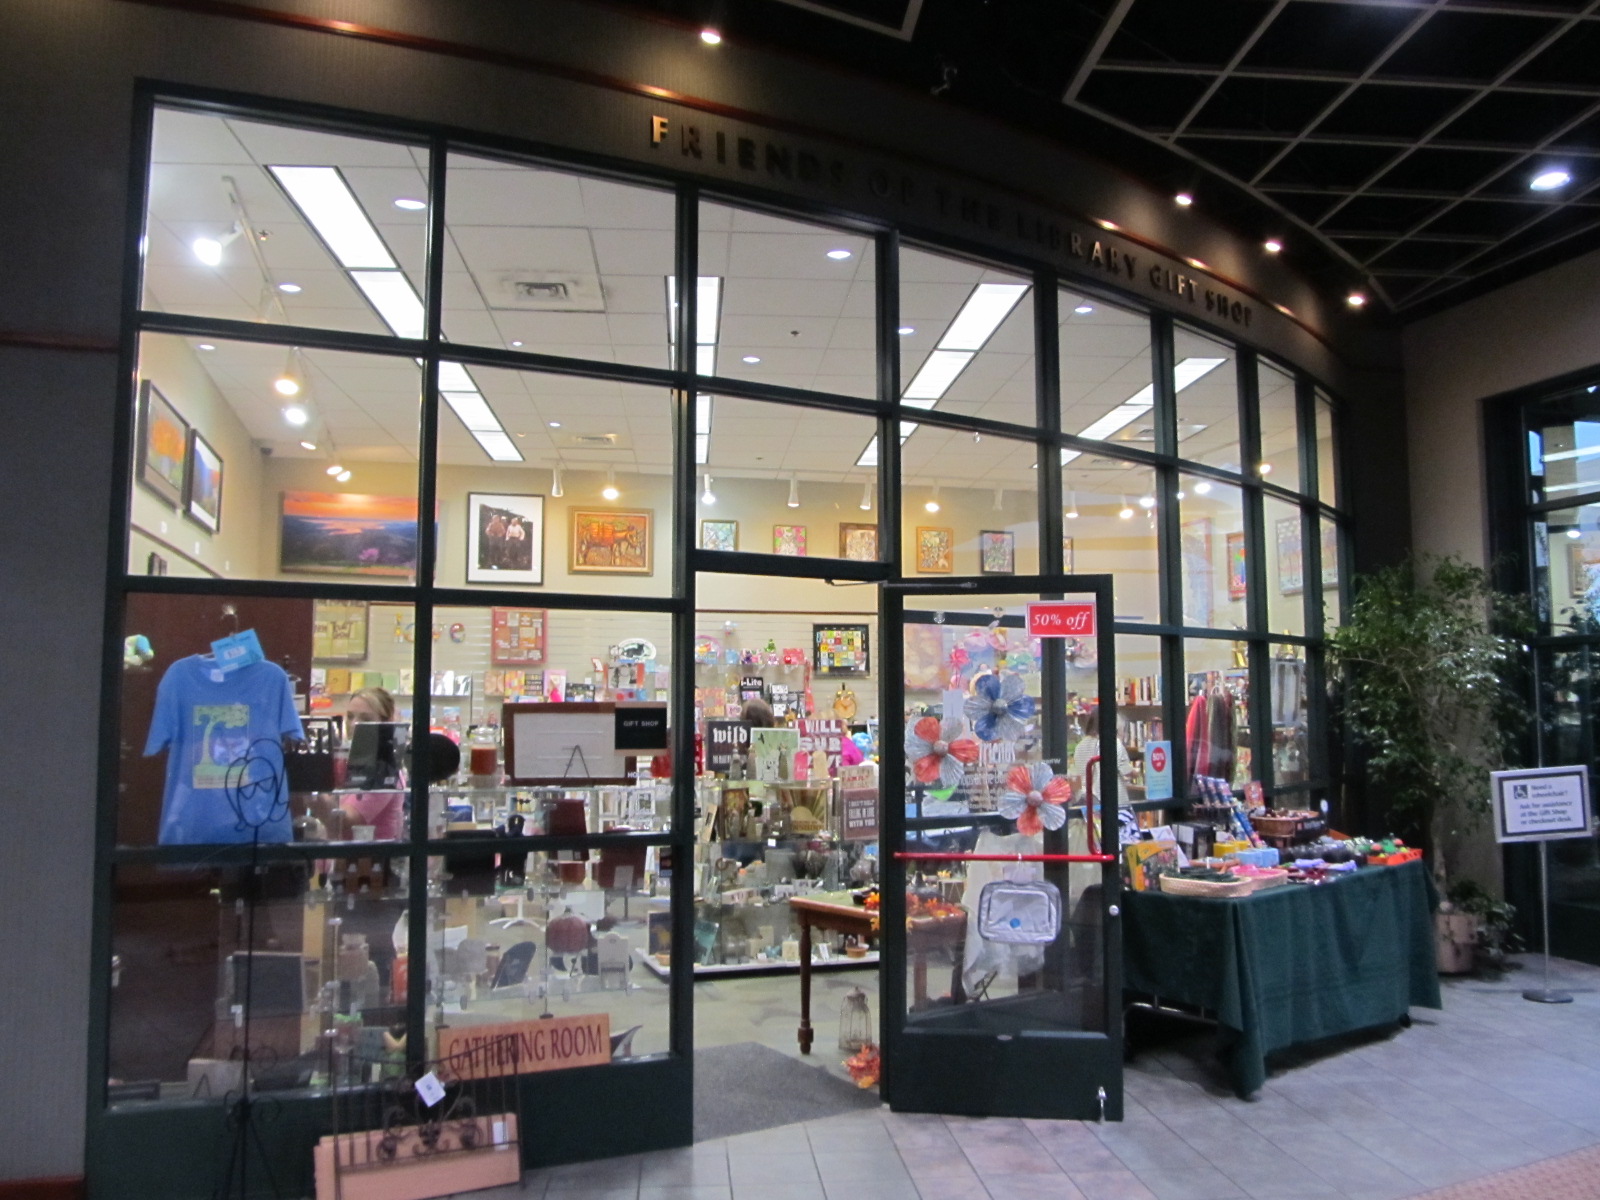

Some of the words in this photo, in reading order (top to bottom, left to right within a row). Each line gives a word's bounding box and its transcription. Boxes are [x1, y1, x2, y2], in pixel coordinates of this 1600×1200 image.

[651, 115, 845, 184] FRIENDS
[934, 187, 1002, 233] THE
[1015, 209, 1138, 280] LIBRARY
[1150, 264, 1199, 300] GIFT
[1205, 289, 1253, 328] SHOP
[1032, 613, 1061, 626] 50%
[1066, 612, 1091, 630] off
[713, 725, 748, 743] wild
[805, 720, 841, 733] WILL
[1528, 817, 1556, 825] checkout
[550, 1024, 603, 1060] ROOM
